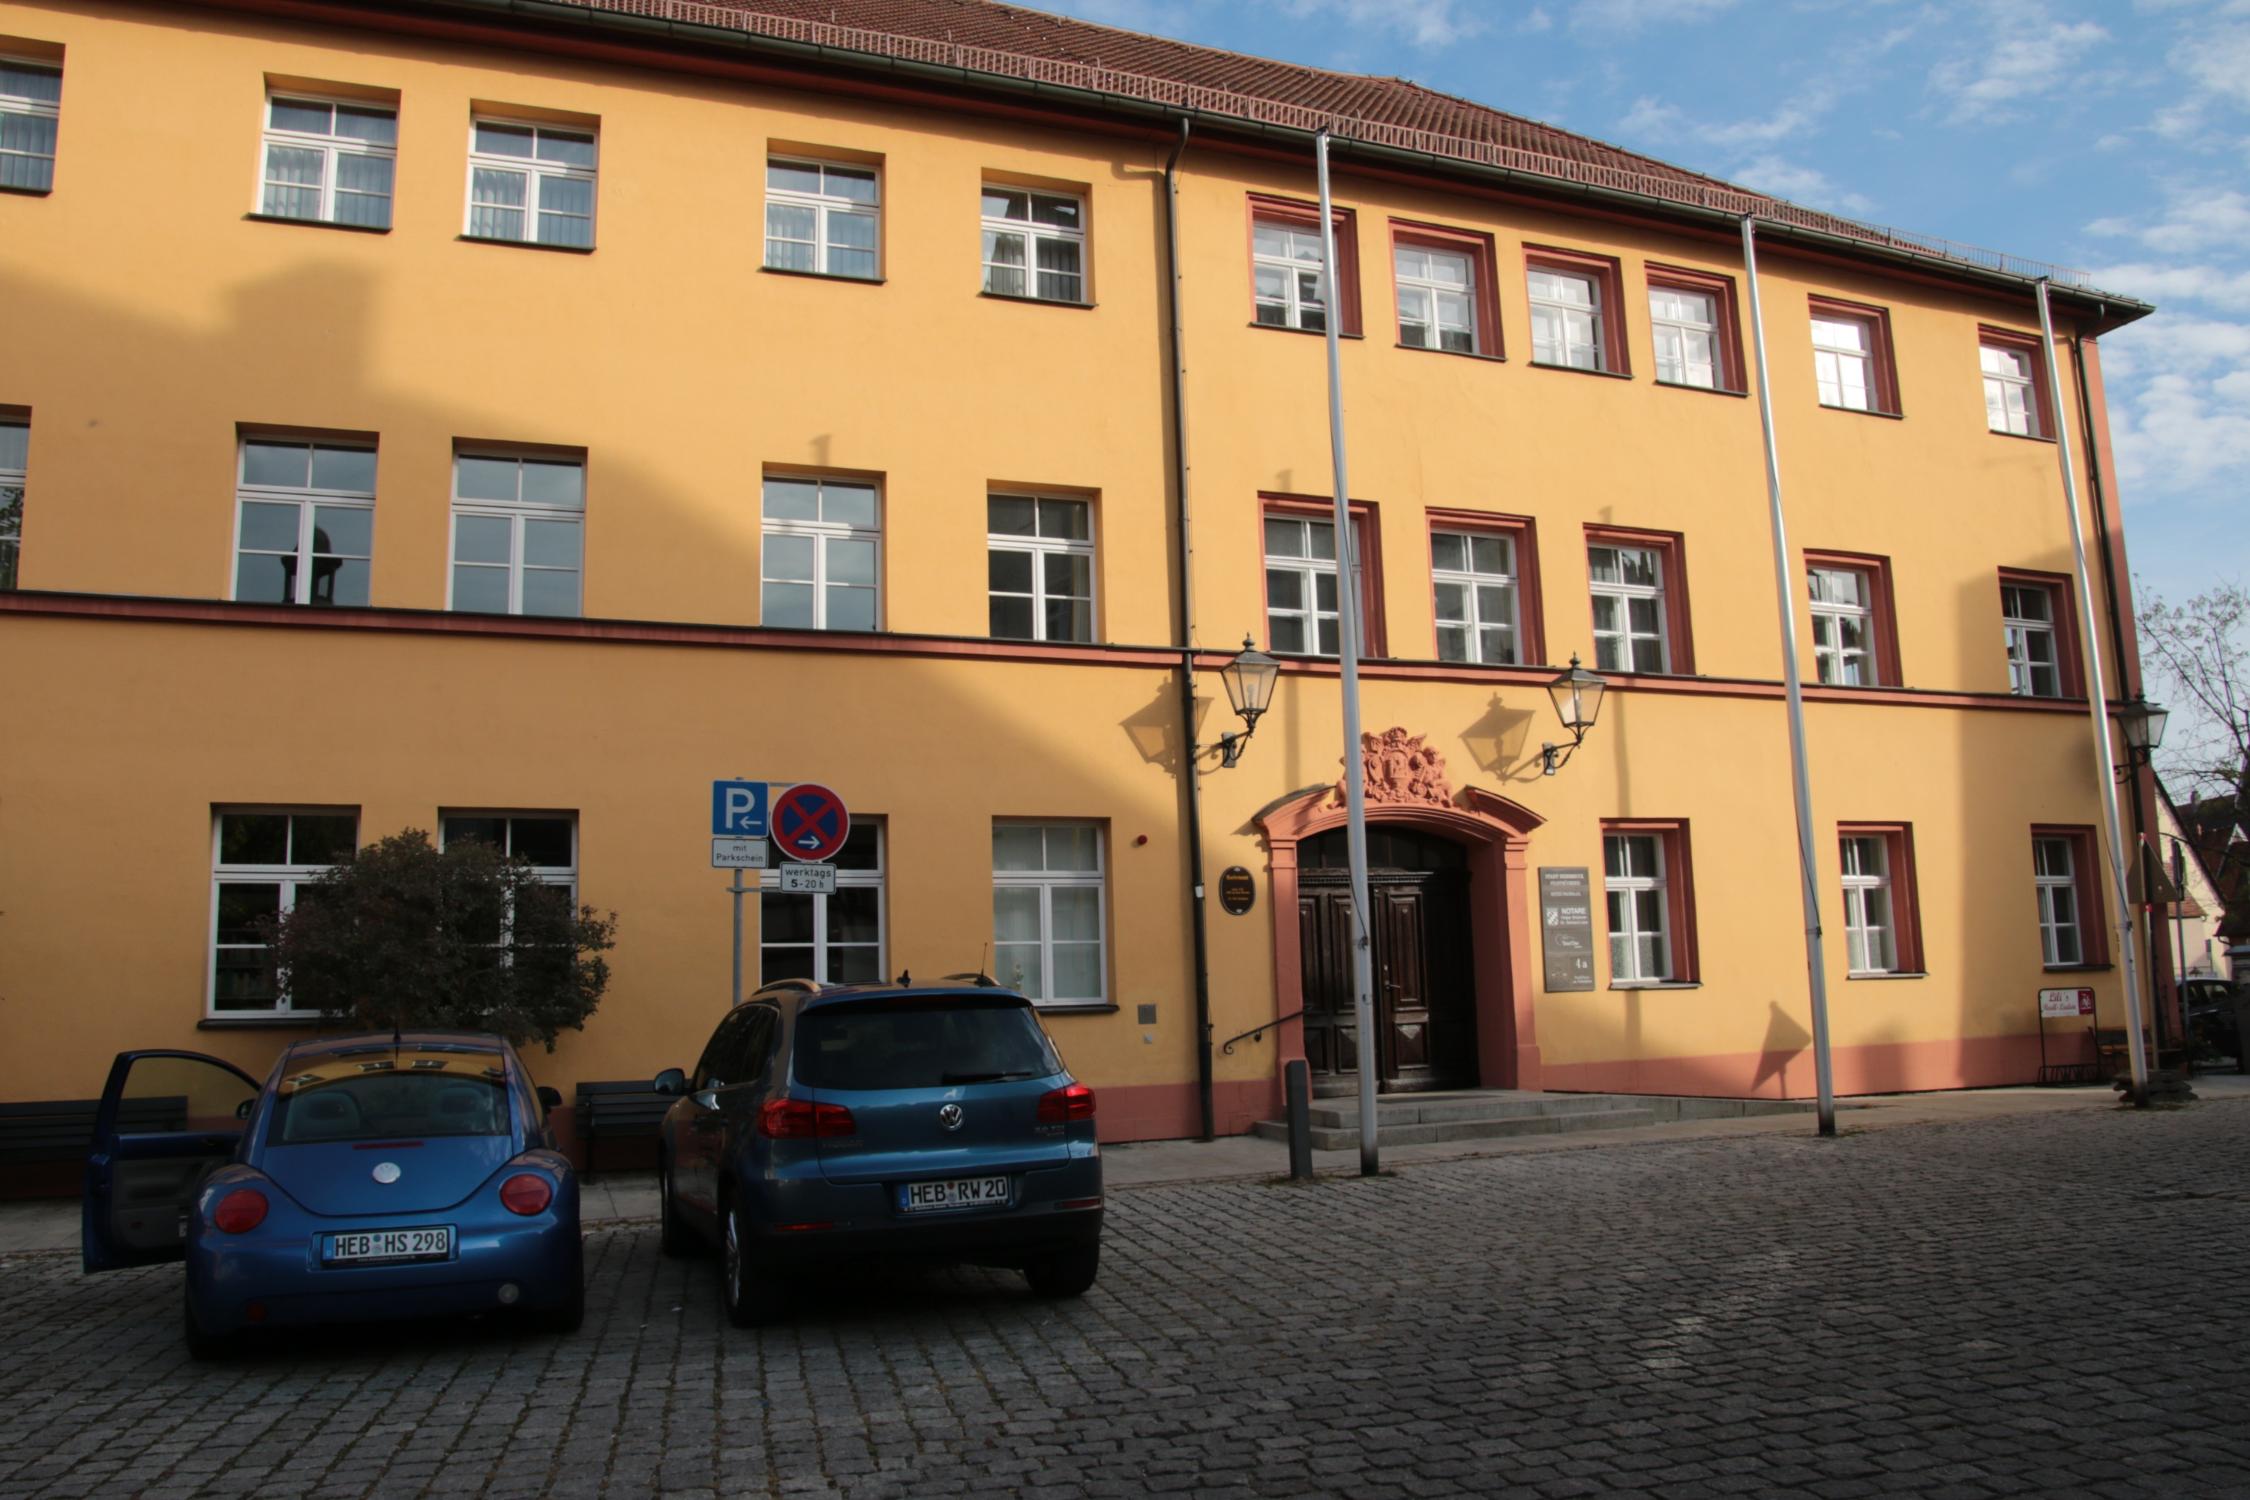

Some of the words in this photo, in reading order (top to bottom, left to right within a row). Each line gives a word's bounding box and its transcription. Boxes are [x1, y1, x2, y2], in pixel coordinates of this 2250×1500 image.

[725, 787, 756, 829] P
[716, 853, 763, 862] Parkschein
[785, 868, 831, 879] werktags
[910, 1183, 946, 1204] HEB
[958, 1181, 981, 1200] RW
[985, 1179, 1006, 1198] 20
[335, 1236, 370, 1257] HEB
[385, 1234, 408, 1253] HS
[412, 1231, 446, 1252] 298
